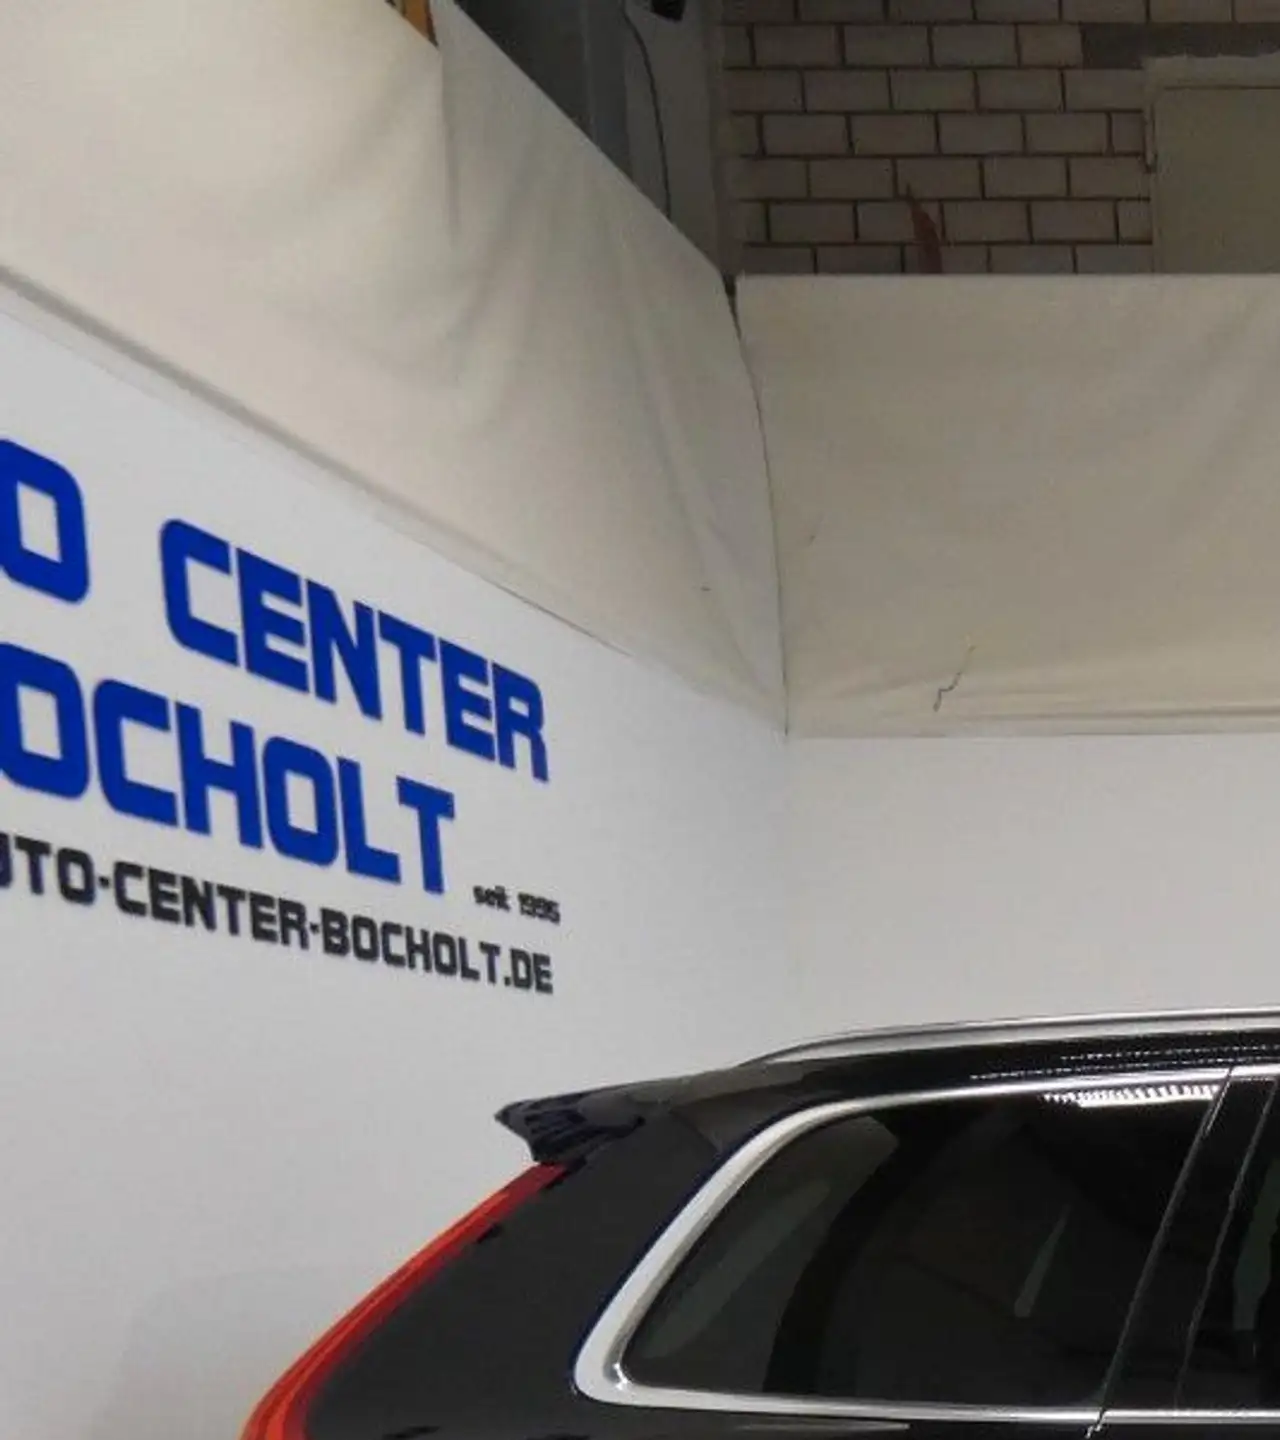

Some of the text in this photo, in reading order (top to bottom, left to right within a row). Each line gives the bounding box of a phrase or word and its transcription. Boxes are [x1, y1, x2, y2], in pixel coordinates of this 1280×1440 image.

[0, 642, 454, 894] OCHOLT
[160, 519, 547, 781] CENTER
[0, 830, 553, 995] TO-CENTER-BOCHOLT.DE
